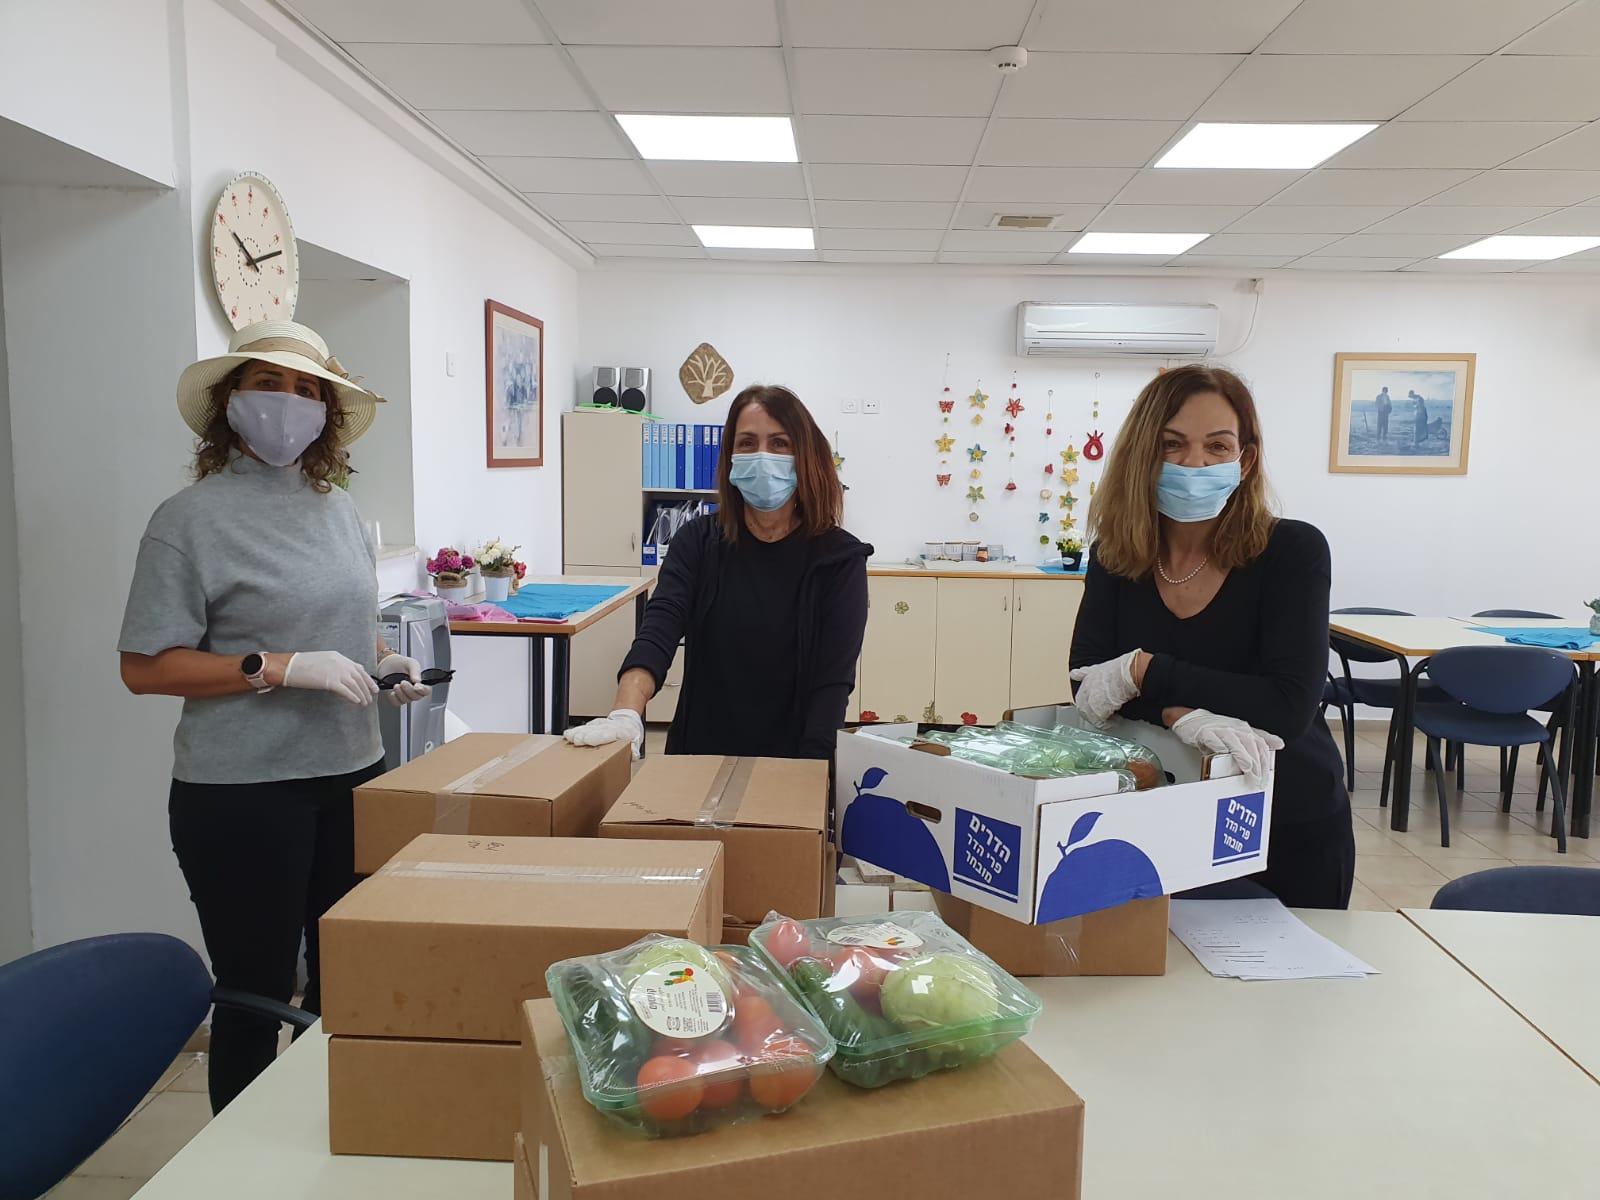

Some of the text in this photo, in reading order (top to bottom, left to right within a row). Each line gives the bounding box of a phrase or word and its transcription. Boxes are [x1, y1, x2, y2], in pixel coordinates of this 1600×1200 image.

[1225, 817, 1250, 840] פרי הדר
[1228, 799, 1257, 827] הדרים
[967, 833, 1002, 874] פרי הדר
[969, 815, 1011, 863] הדרים
[1223, 833, 1244, 853] מובחר
[965, 850, 993, 884] מובחר
